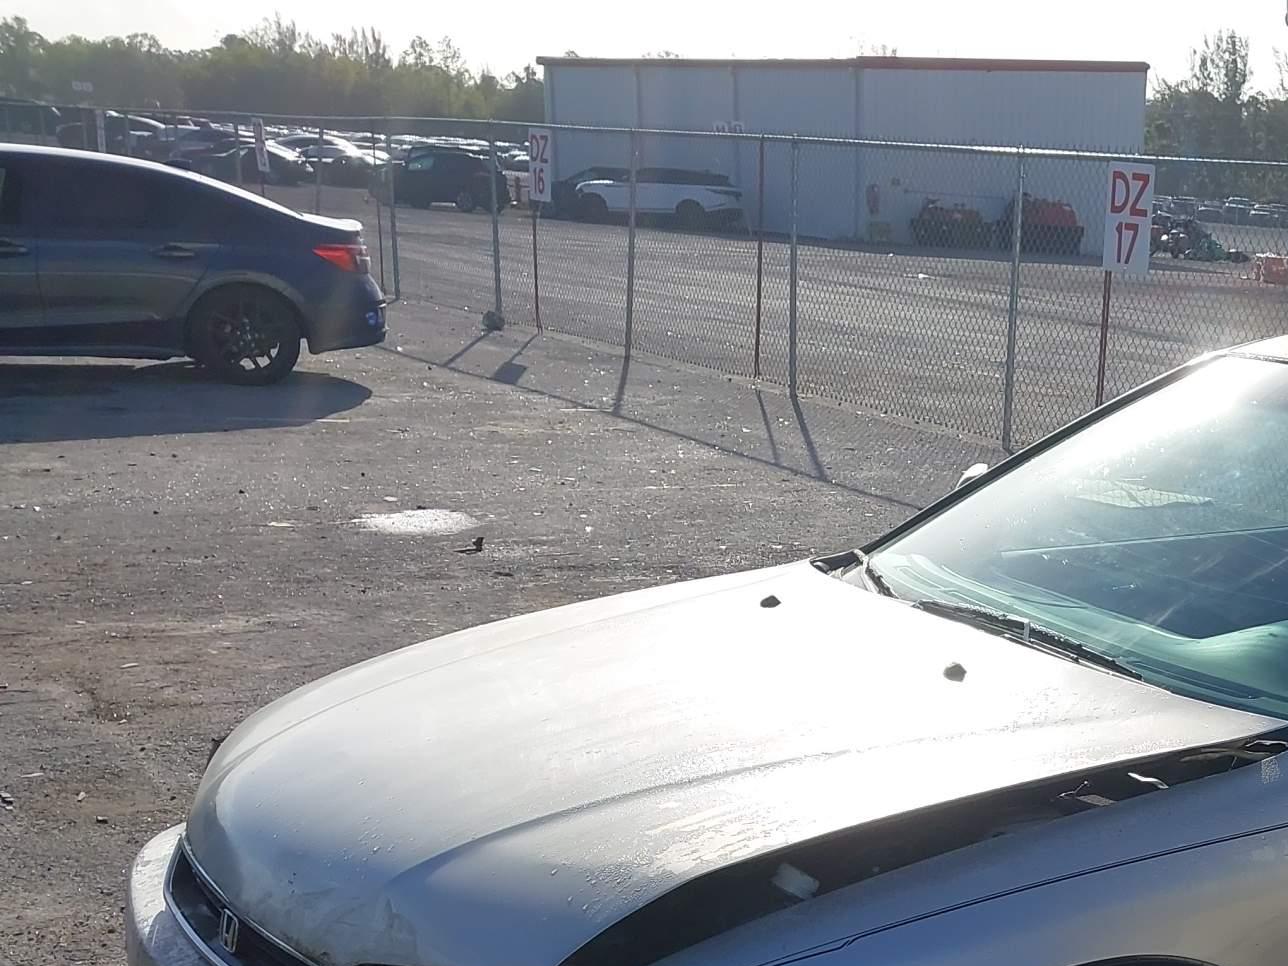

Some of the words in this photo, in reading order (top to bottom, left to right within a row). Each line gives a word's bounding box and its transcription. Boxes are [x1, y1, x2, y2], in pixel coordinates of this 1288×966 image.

[530, 134, 548, 163] DZ
[534, 167, 545, 194] 16
[1110, 170, 1150, 217] DZ
[1115, 222, 1139, 264] 17
